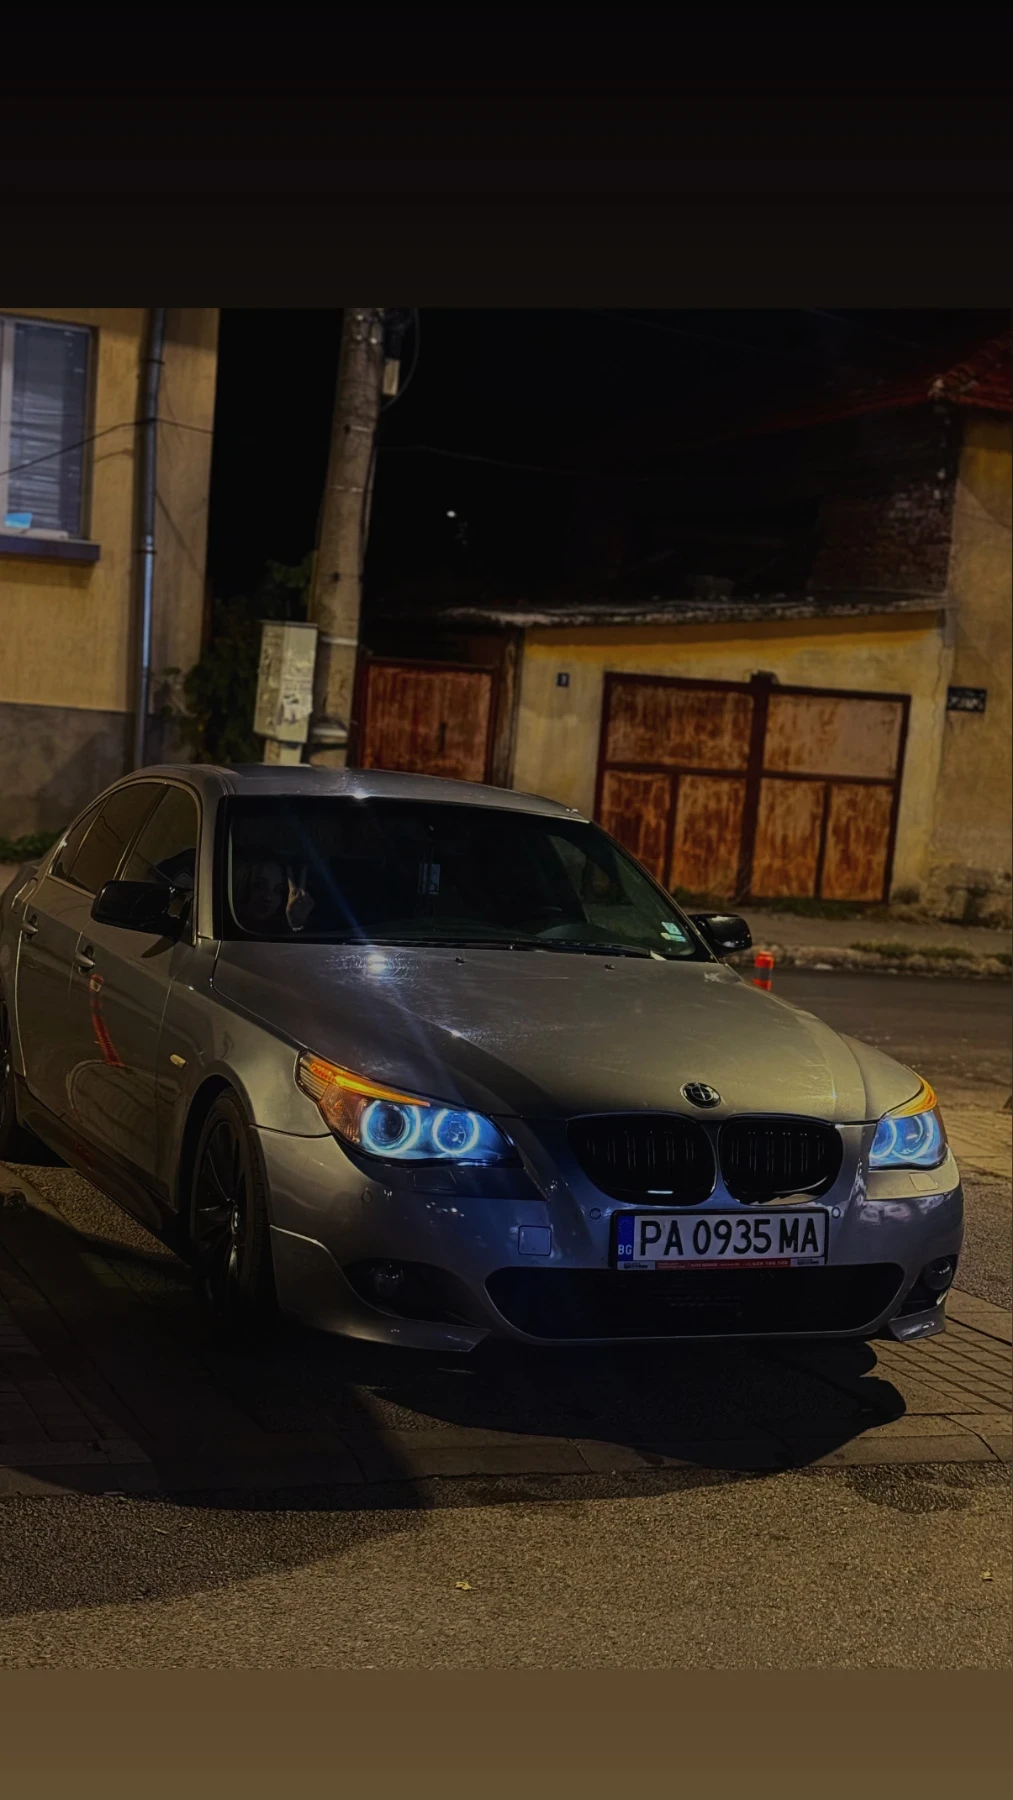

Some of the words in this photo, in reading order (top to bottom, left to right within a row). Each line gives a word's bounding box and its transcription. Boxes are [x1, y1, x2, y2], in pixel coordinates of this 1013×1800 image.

[640, 1219, 683, 1256] PA
[693, 1219, 772, 1255] 0935
[779, 1218, 818, 1254] MA
[618, 1245, 632, 1255] BG
